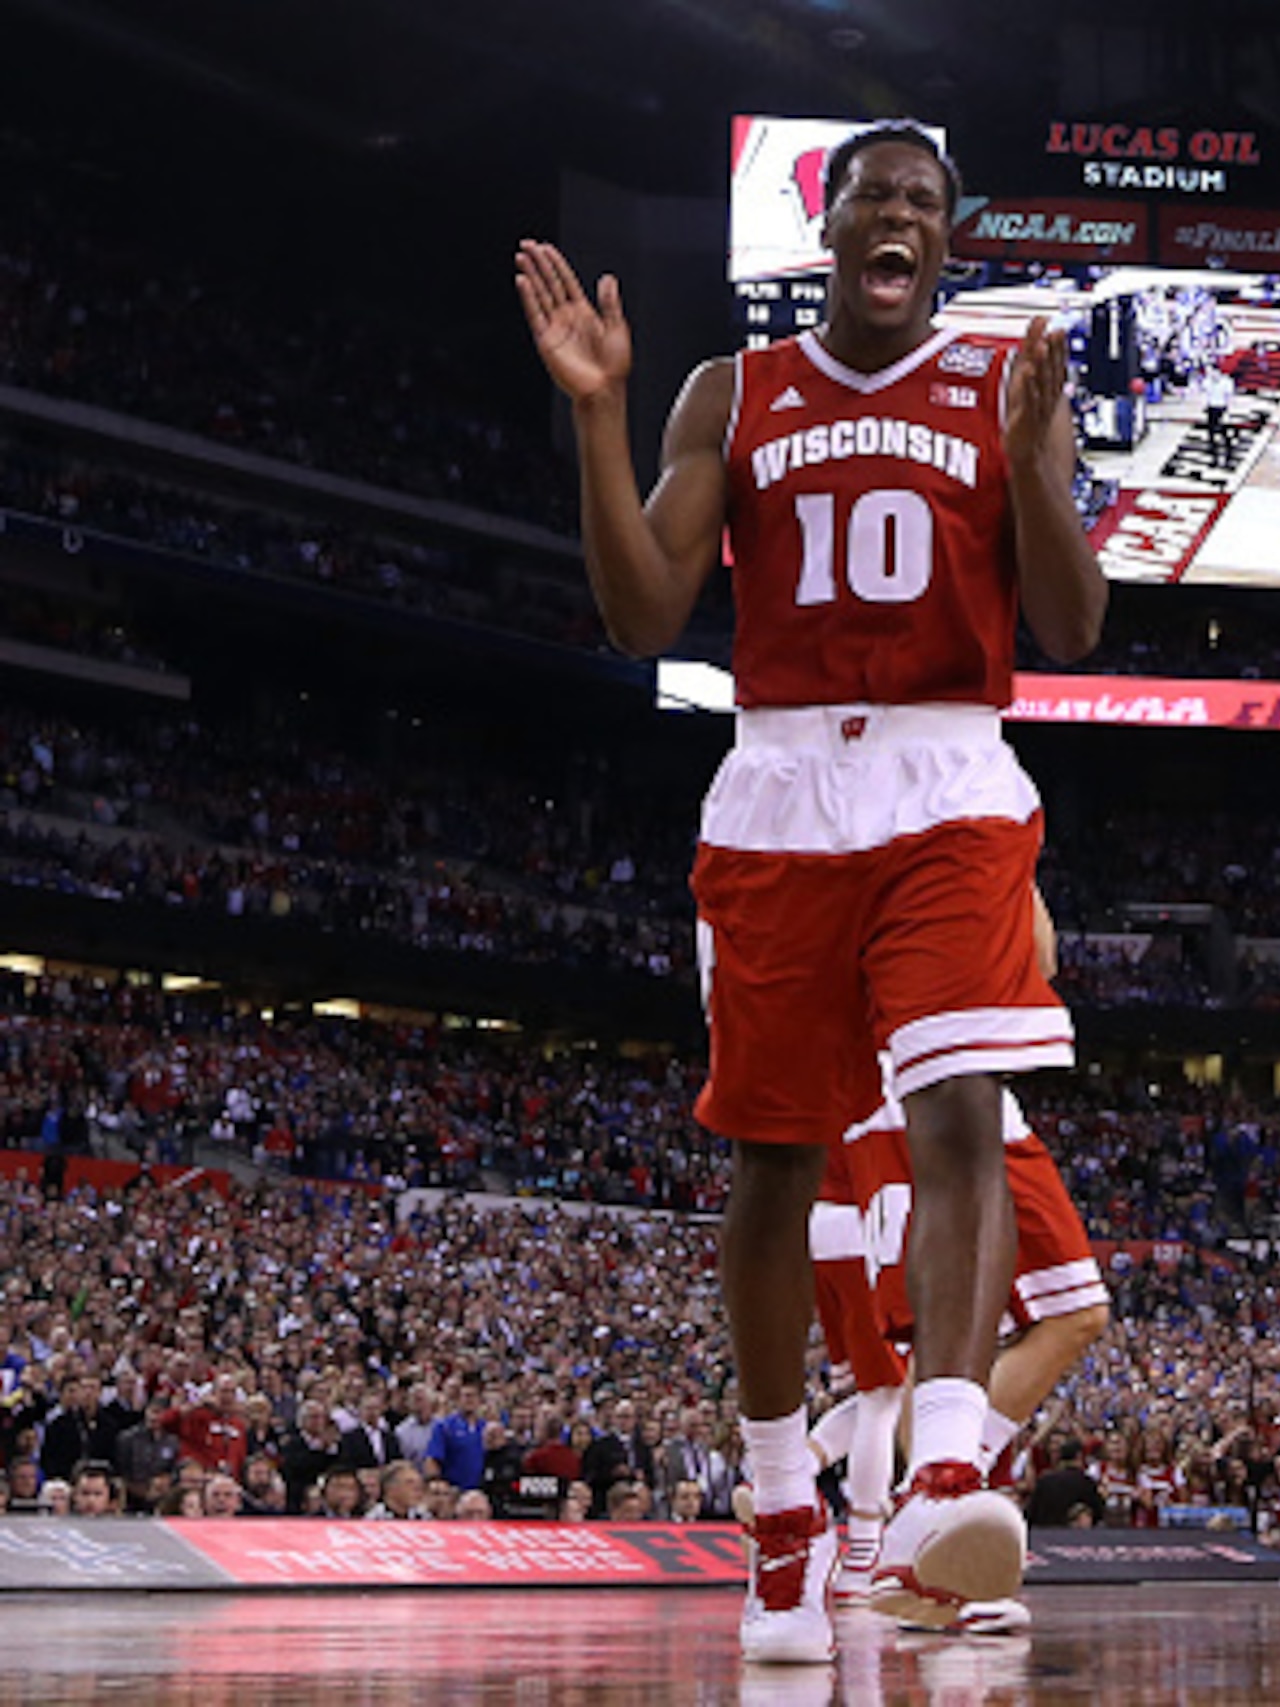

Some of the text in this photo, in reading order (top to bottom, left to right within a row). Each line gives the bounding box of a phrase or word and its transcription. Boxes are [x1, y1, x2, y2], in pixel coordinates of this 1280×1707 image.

[1046, 122, 1261, 165] LUCAS OIL
[1083, 160, 1227, 192] STADIUM
[751, 416, 979, 489] WISCONSIN
[795, 488, 933, 606] 10
[326, 1526, 610, 1549] AND THEN
[246, 1549, 645, 1573] THERE WERE
